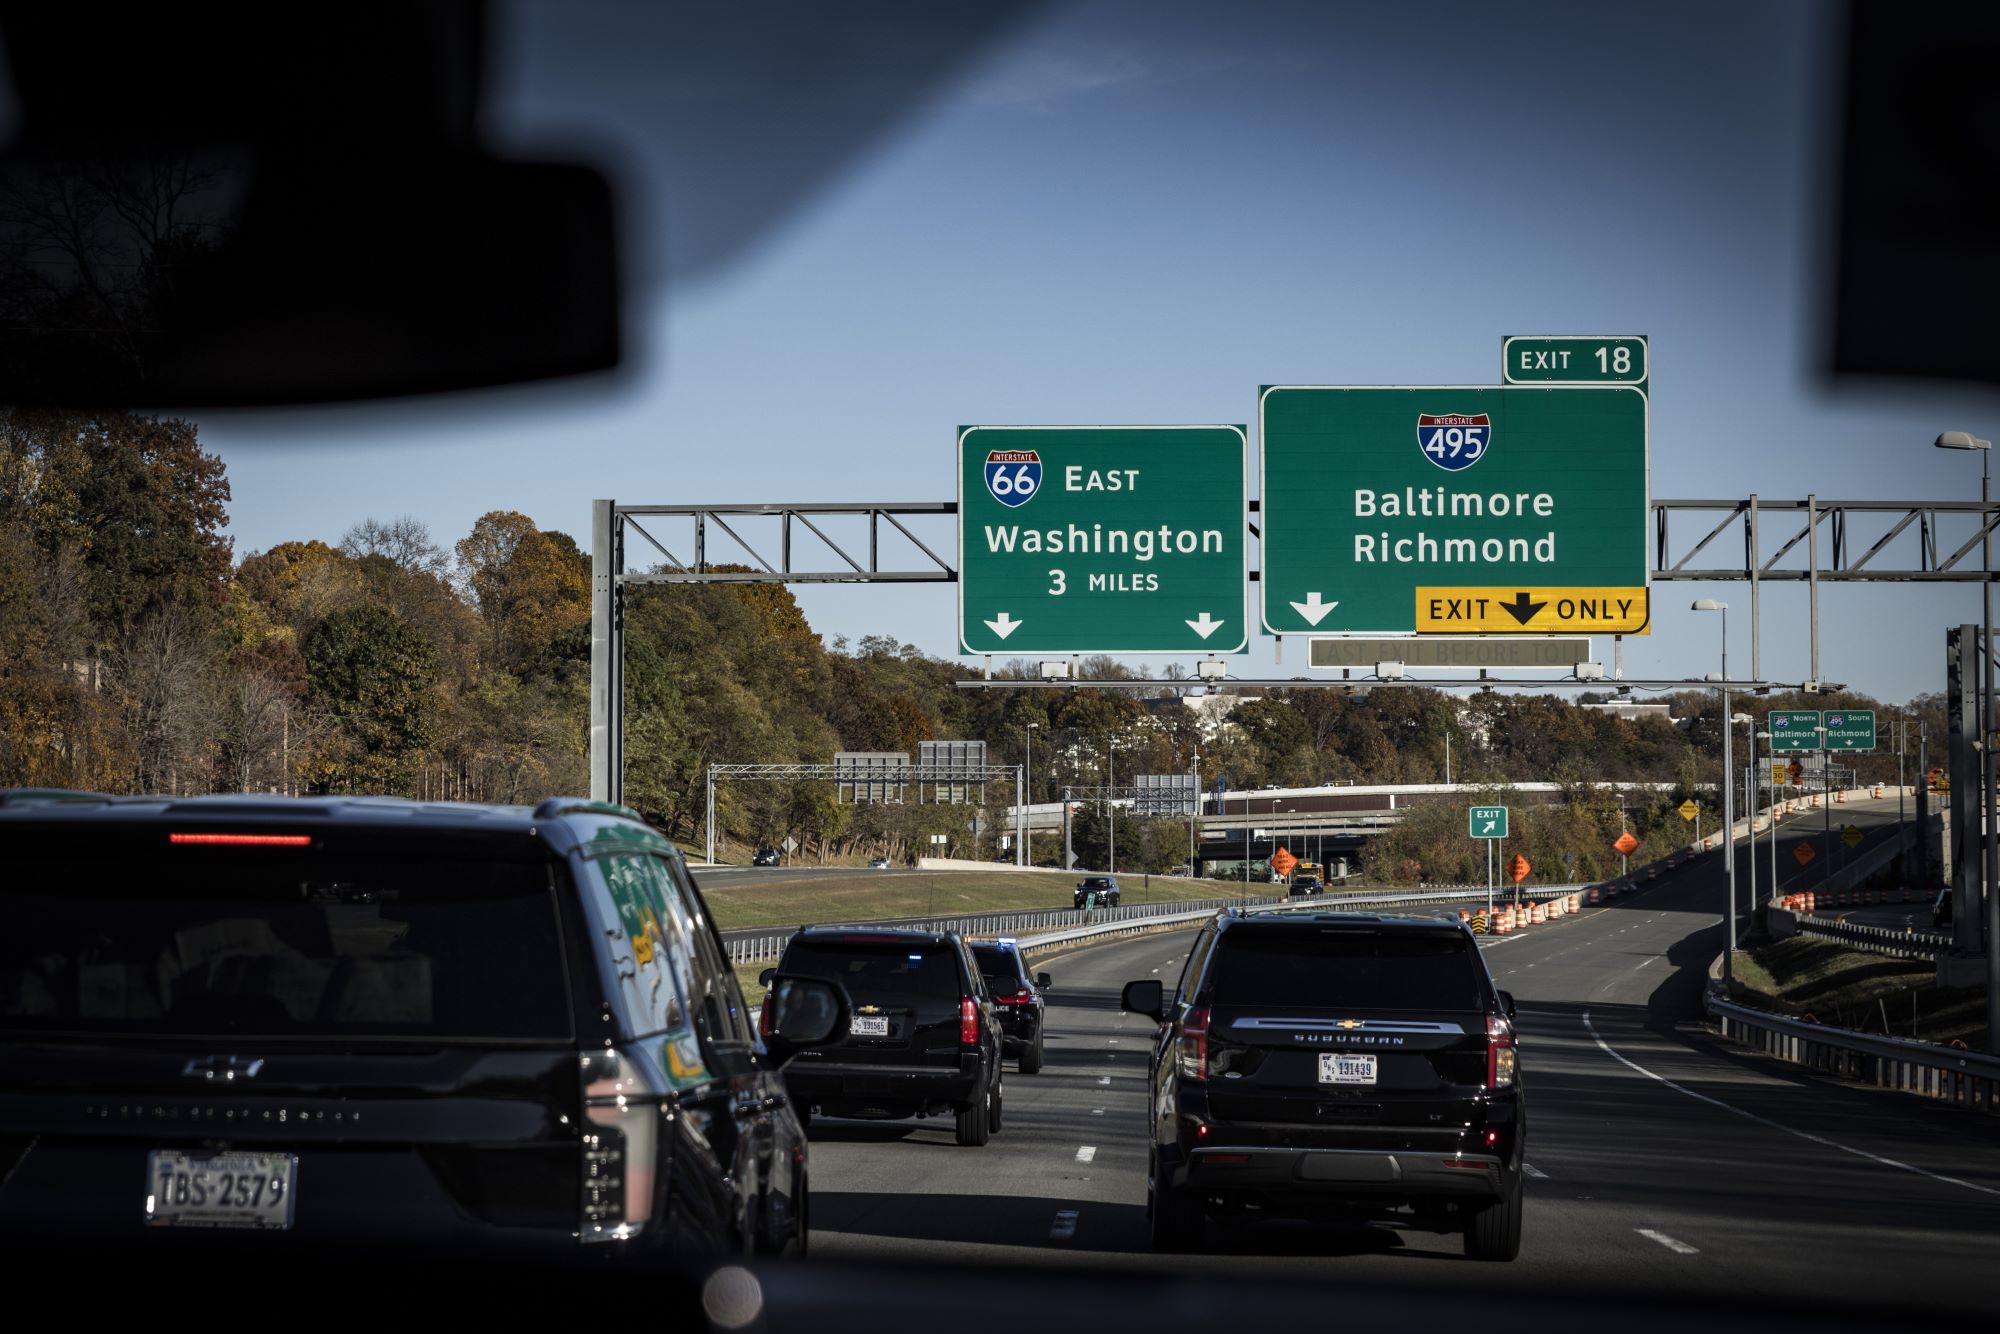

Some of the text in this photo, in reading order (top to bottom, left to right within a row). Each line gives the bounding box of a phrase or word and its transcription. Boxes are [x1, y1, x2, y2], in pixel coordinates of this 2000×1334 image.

[1521, 346, 1631, 374] EXIT 18
[1434, 417, 1474, 425] INTERSTATE
[1425, 427, 1482, 459] 495
[993, 453, 1033, 461] INTERSTATE
[992, 464, 1140, 495] 66 EAST
[1355, 486, 1554, 517] Baltimore
[984, 523, 1223, 561] Washington
[1354, 531, 1555, 563] Richmond
[1048, 569, 1159, 596] 3 MILES
[1430, 598, 1633, 620] EXIT ONLY
[1314, 642, 1582, 662] LAST EXIT BEFORE TOLL
[1774, 730, 1816, 738] Baltimore
[1476, 810, 1500, 819] EXIT
[1294, 1034, 1404, 1045] SUBURBAN
[1338, 1062, 1371, 1076] 131439
